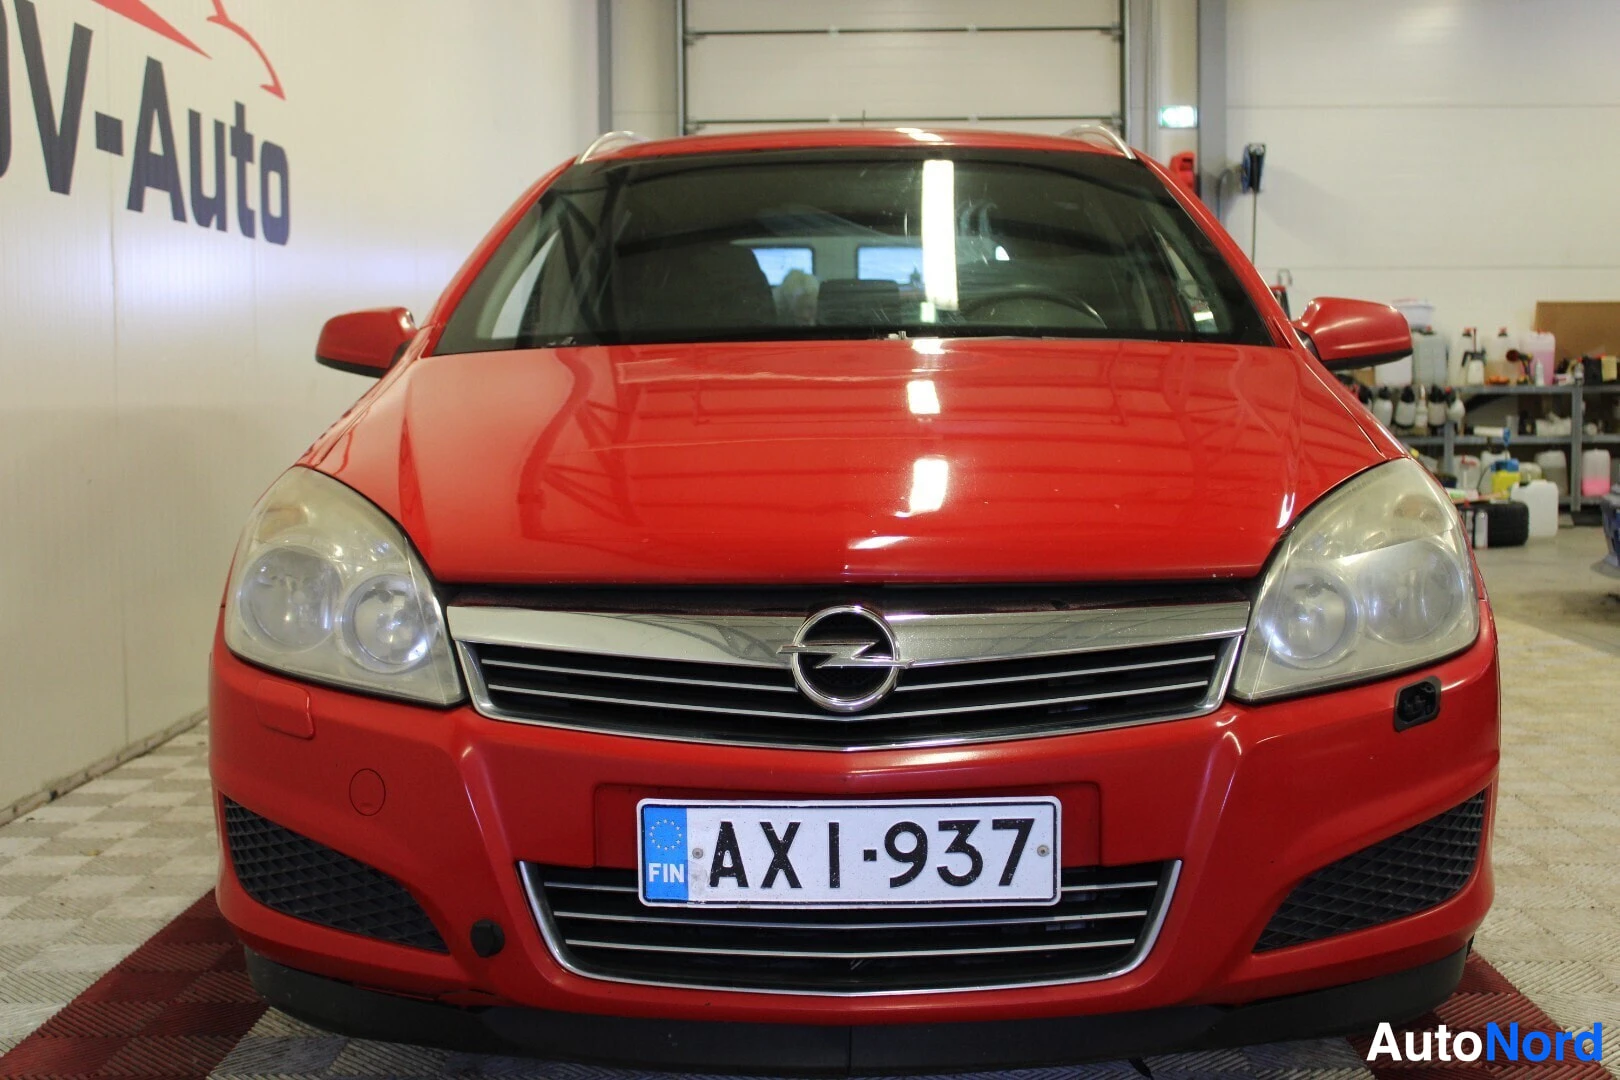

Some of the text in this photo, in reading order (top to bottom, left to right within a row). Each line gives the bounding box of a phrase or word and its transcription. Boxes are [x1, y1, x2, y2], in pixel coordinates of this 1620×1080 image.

[0, 0, 290, 246] V-Auto
[648, 862, 685, 883] FIN
[708, 817, 1036, 889] AXI-937
